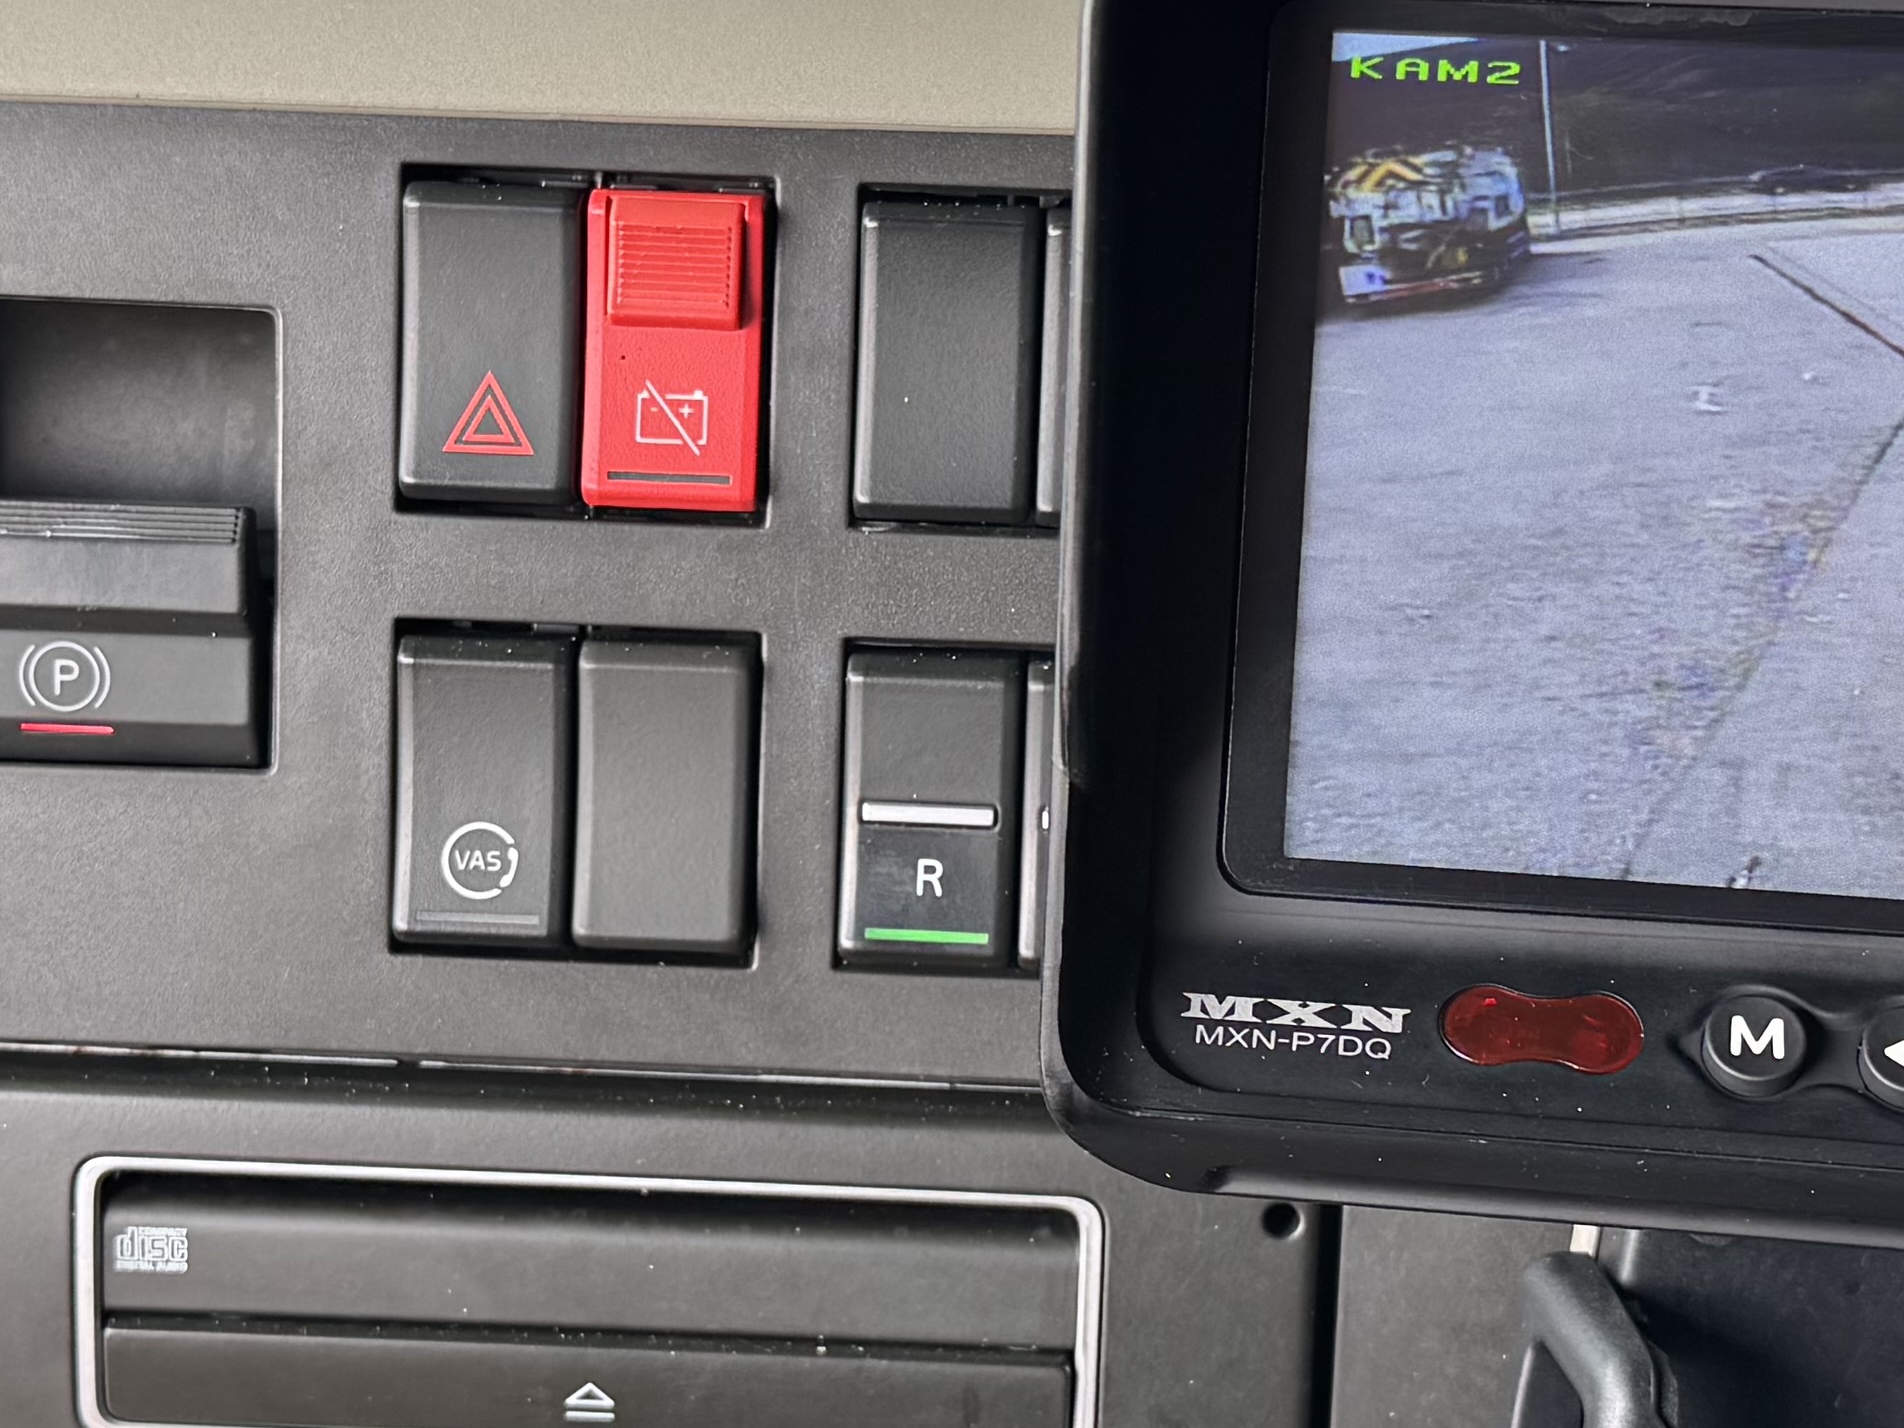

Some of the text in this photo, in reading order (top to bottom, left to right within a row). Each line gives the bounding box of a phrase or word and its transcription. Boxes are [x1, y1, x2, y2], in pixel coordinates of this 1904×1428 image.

[1351, 56, 1521, 85] KAM2
[53, 660, 80, 695] P
[454, 851, 503, 872] VAS
[916, 860, 943, 897] R
[1180, 992, 1411, 1033] MXN
[1195, 1024, 1392, 1060] MXN-P7DQ
[1730, 1016, 1785, 1059] M
